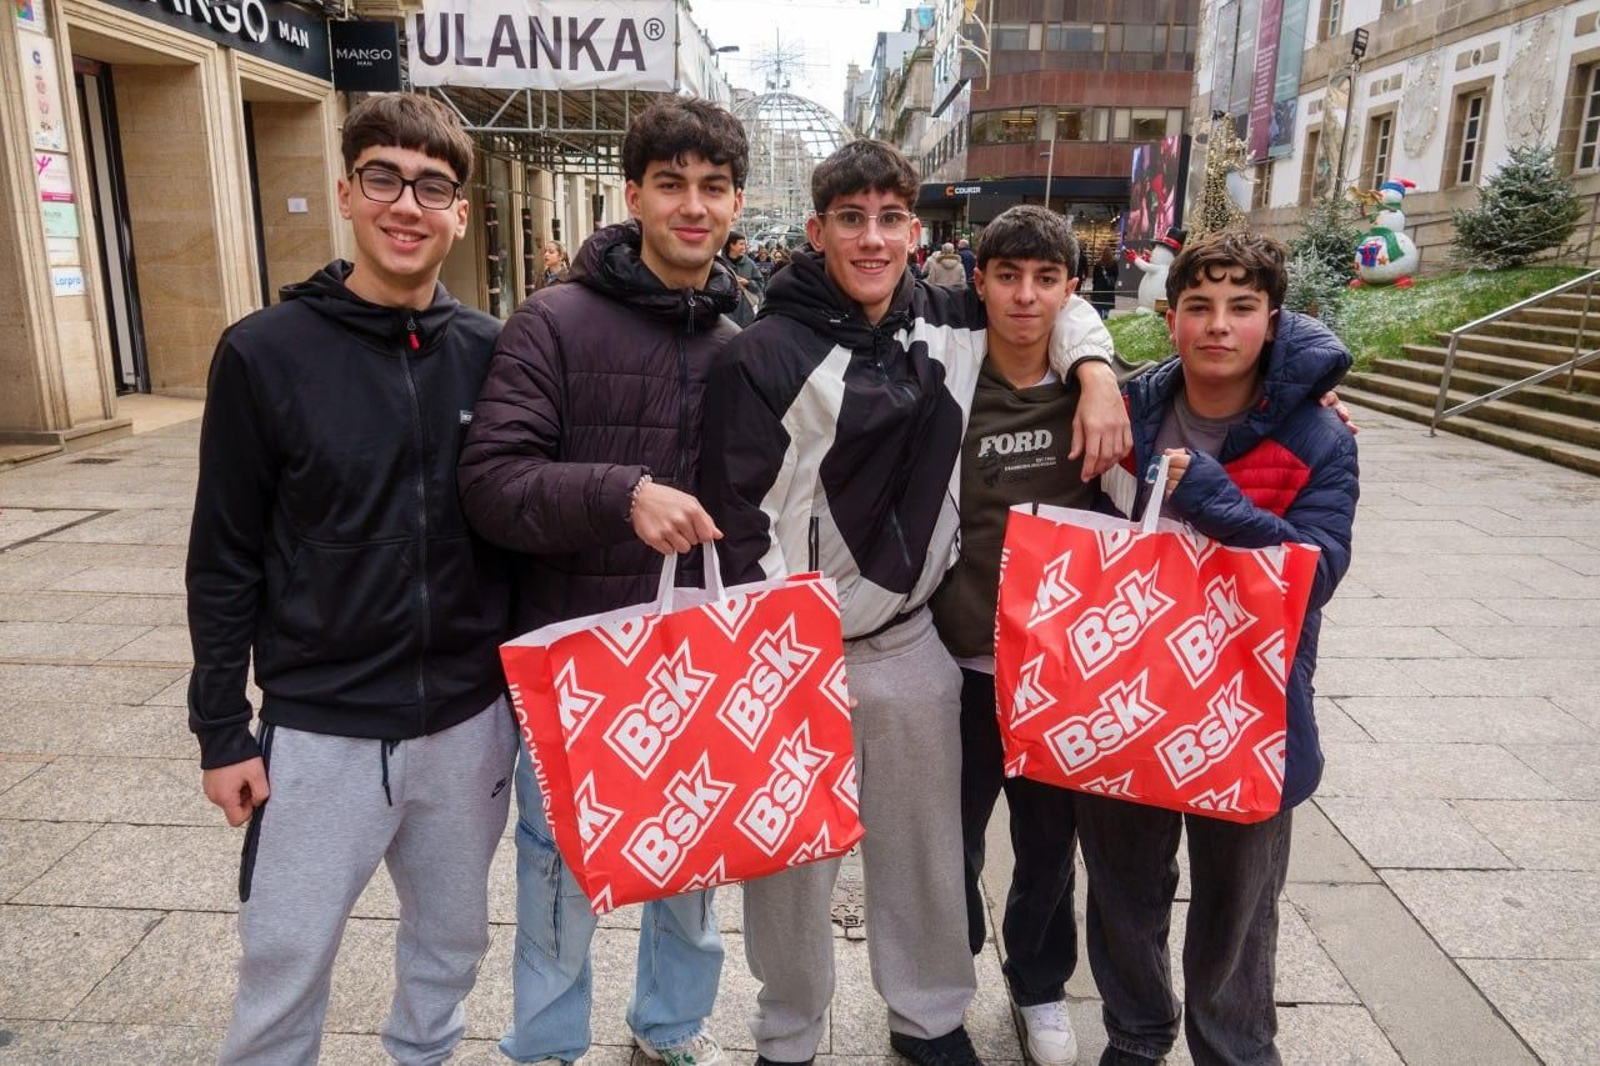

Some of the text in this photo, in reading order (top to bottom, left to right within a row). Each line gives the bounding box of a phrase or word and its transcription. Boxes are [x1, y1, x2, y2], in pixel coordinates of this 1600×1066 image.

[278, 20, 309, 49] MAN
[336, 48, 392, 60] MANGO
[977, 429, 1053, 457] FORD
